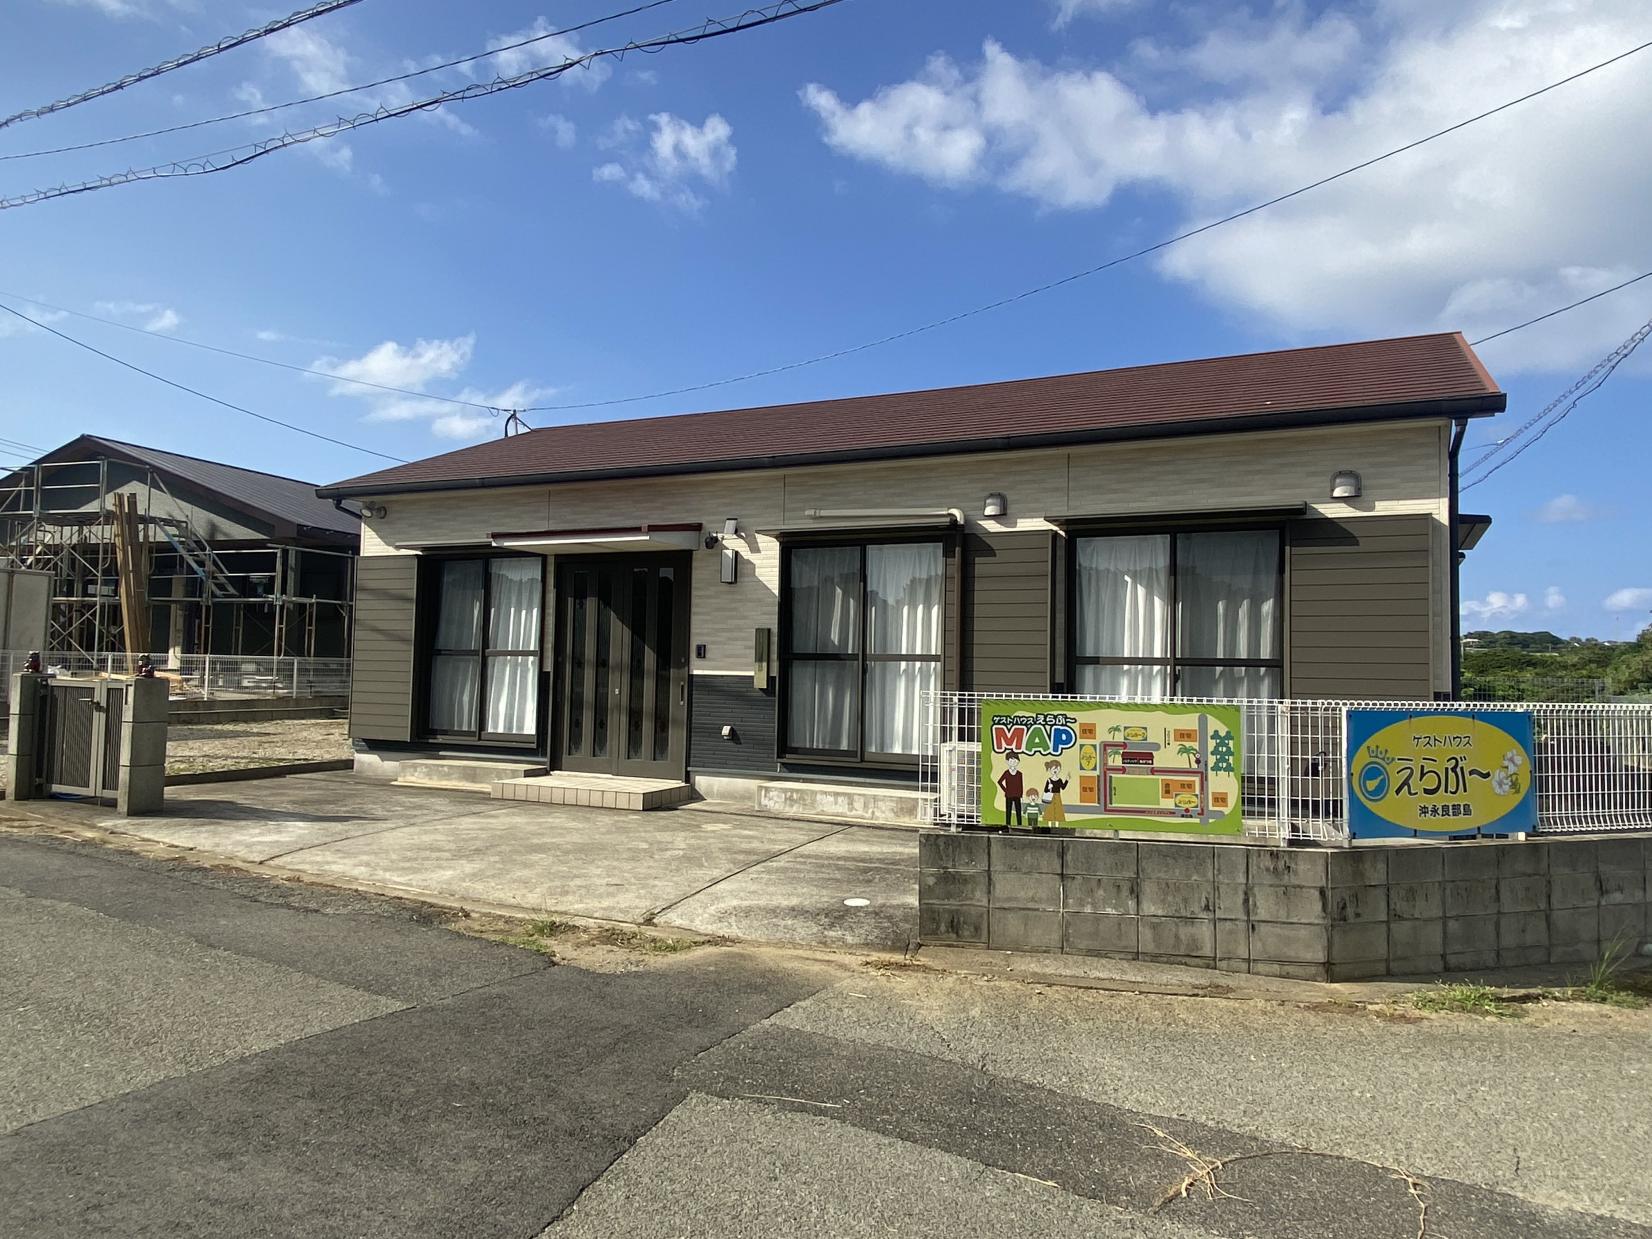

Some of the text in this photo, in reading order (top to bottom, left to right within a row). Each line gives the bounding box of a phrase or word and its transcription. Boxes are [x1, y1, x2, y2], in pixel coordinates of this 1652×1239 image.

[992, 725, 1076, 755] MAP
[1412, 735, 1473, 748] ゲストハウス
[1418, 803, 1473, 817] 沖永良部島
